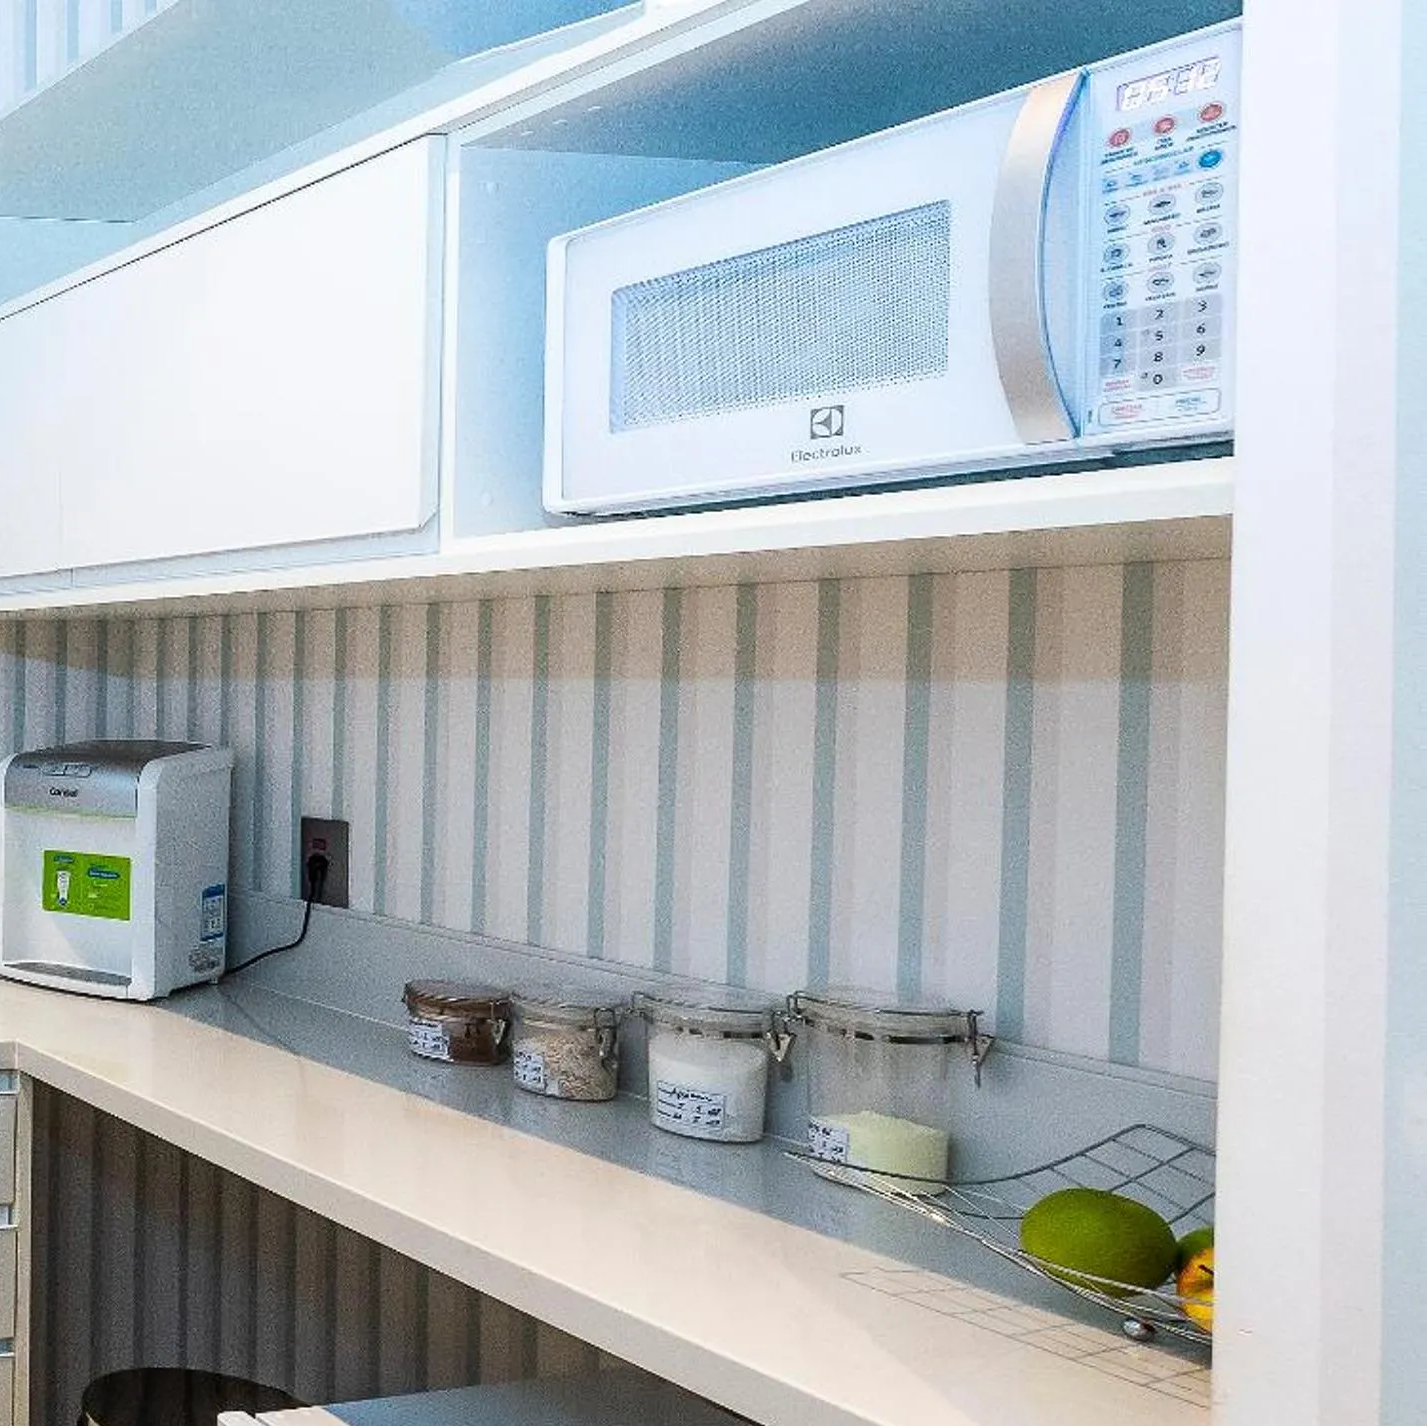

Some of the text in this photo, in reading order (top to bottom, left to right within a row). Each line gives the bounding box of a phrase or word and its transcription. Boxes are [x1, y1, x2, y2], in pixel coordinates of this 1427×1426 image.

[1116, 300, 1207, 326] 1 2 3
[1114, 322, 1206, 347] 4 5 6
[1113, 344, 1206, 368] 7 8 9
[1153, 374, 1163, 385] 0
[790, 445, 862, 462] Electrolux
